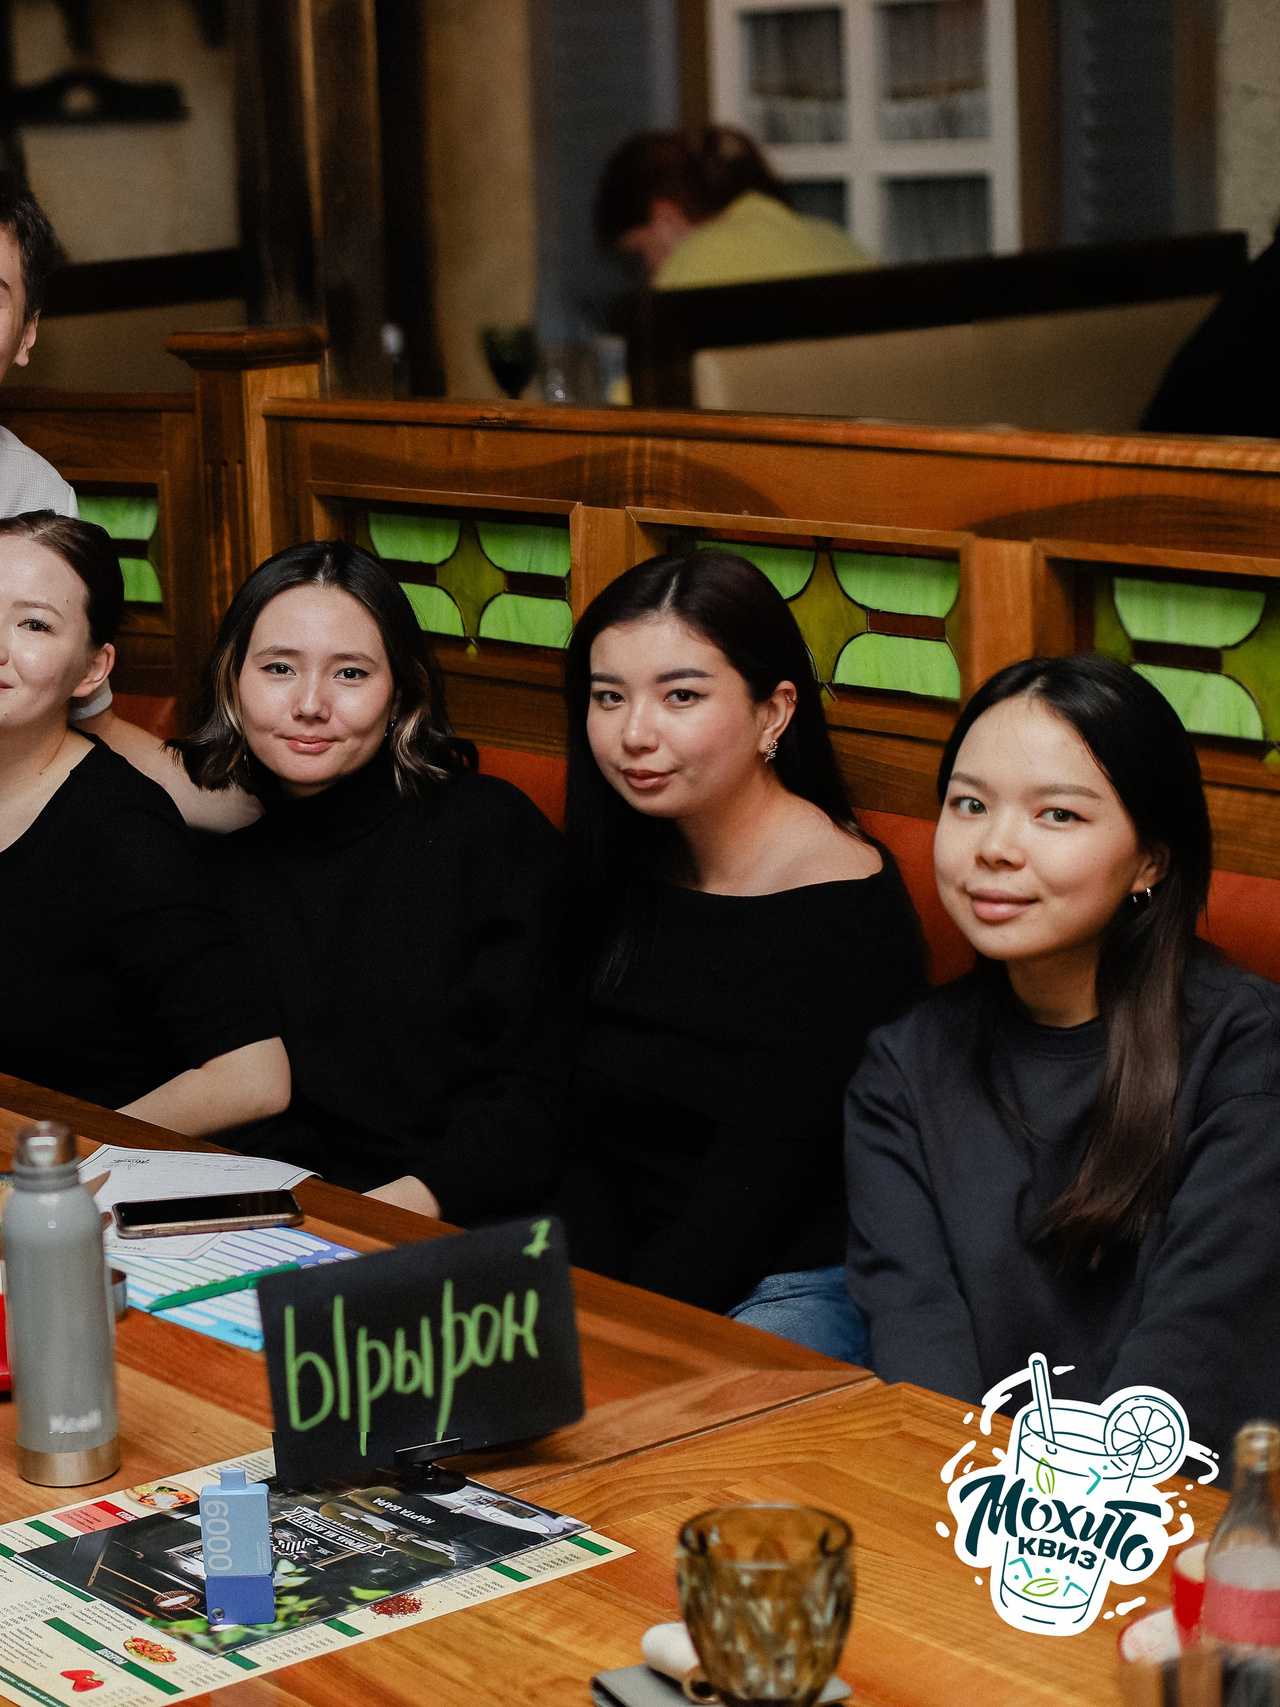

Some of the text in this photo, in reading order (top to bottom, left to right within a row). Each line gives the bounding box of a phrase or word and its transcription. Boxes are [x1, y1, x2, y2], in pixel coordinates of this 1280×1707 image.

[203, 1500, 233, 1571] 6000
[372, 1497, 436, 1525] КАРТА БАРА
